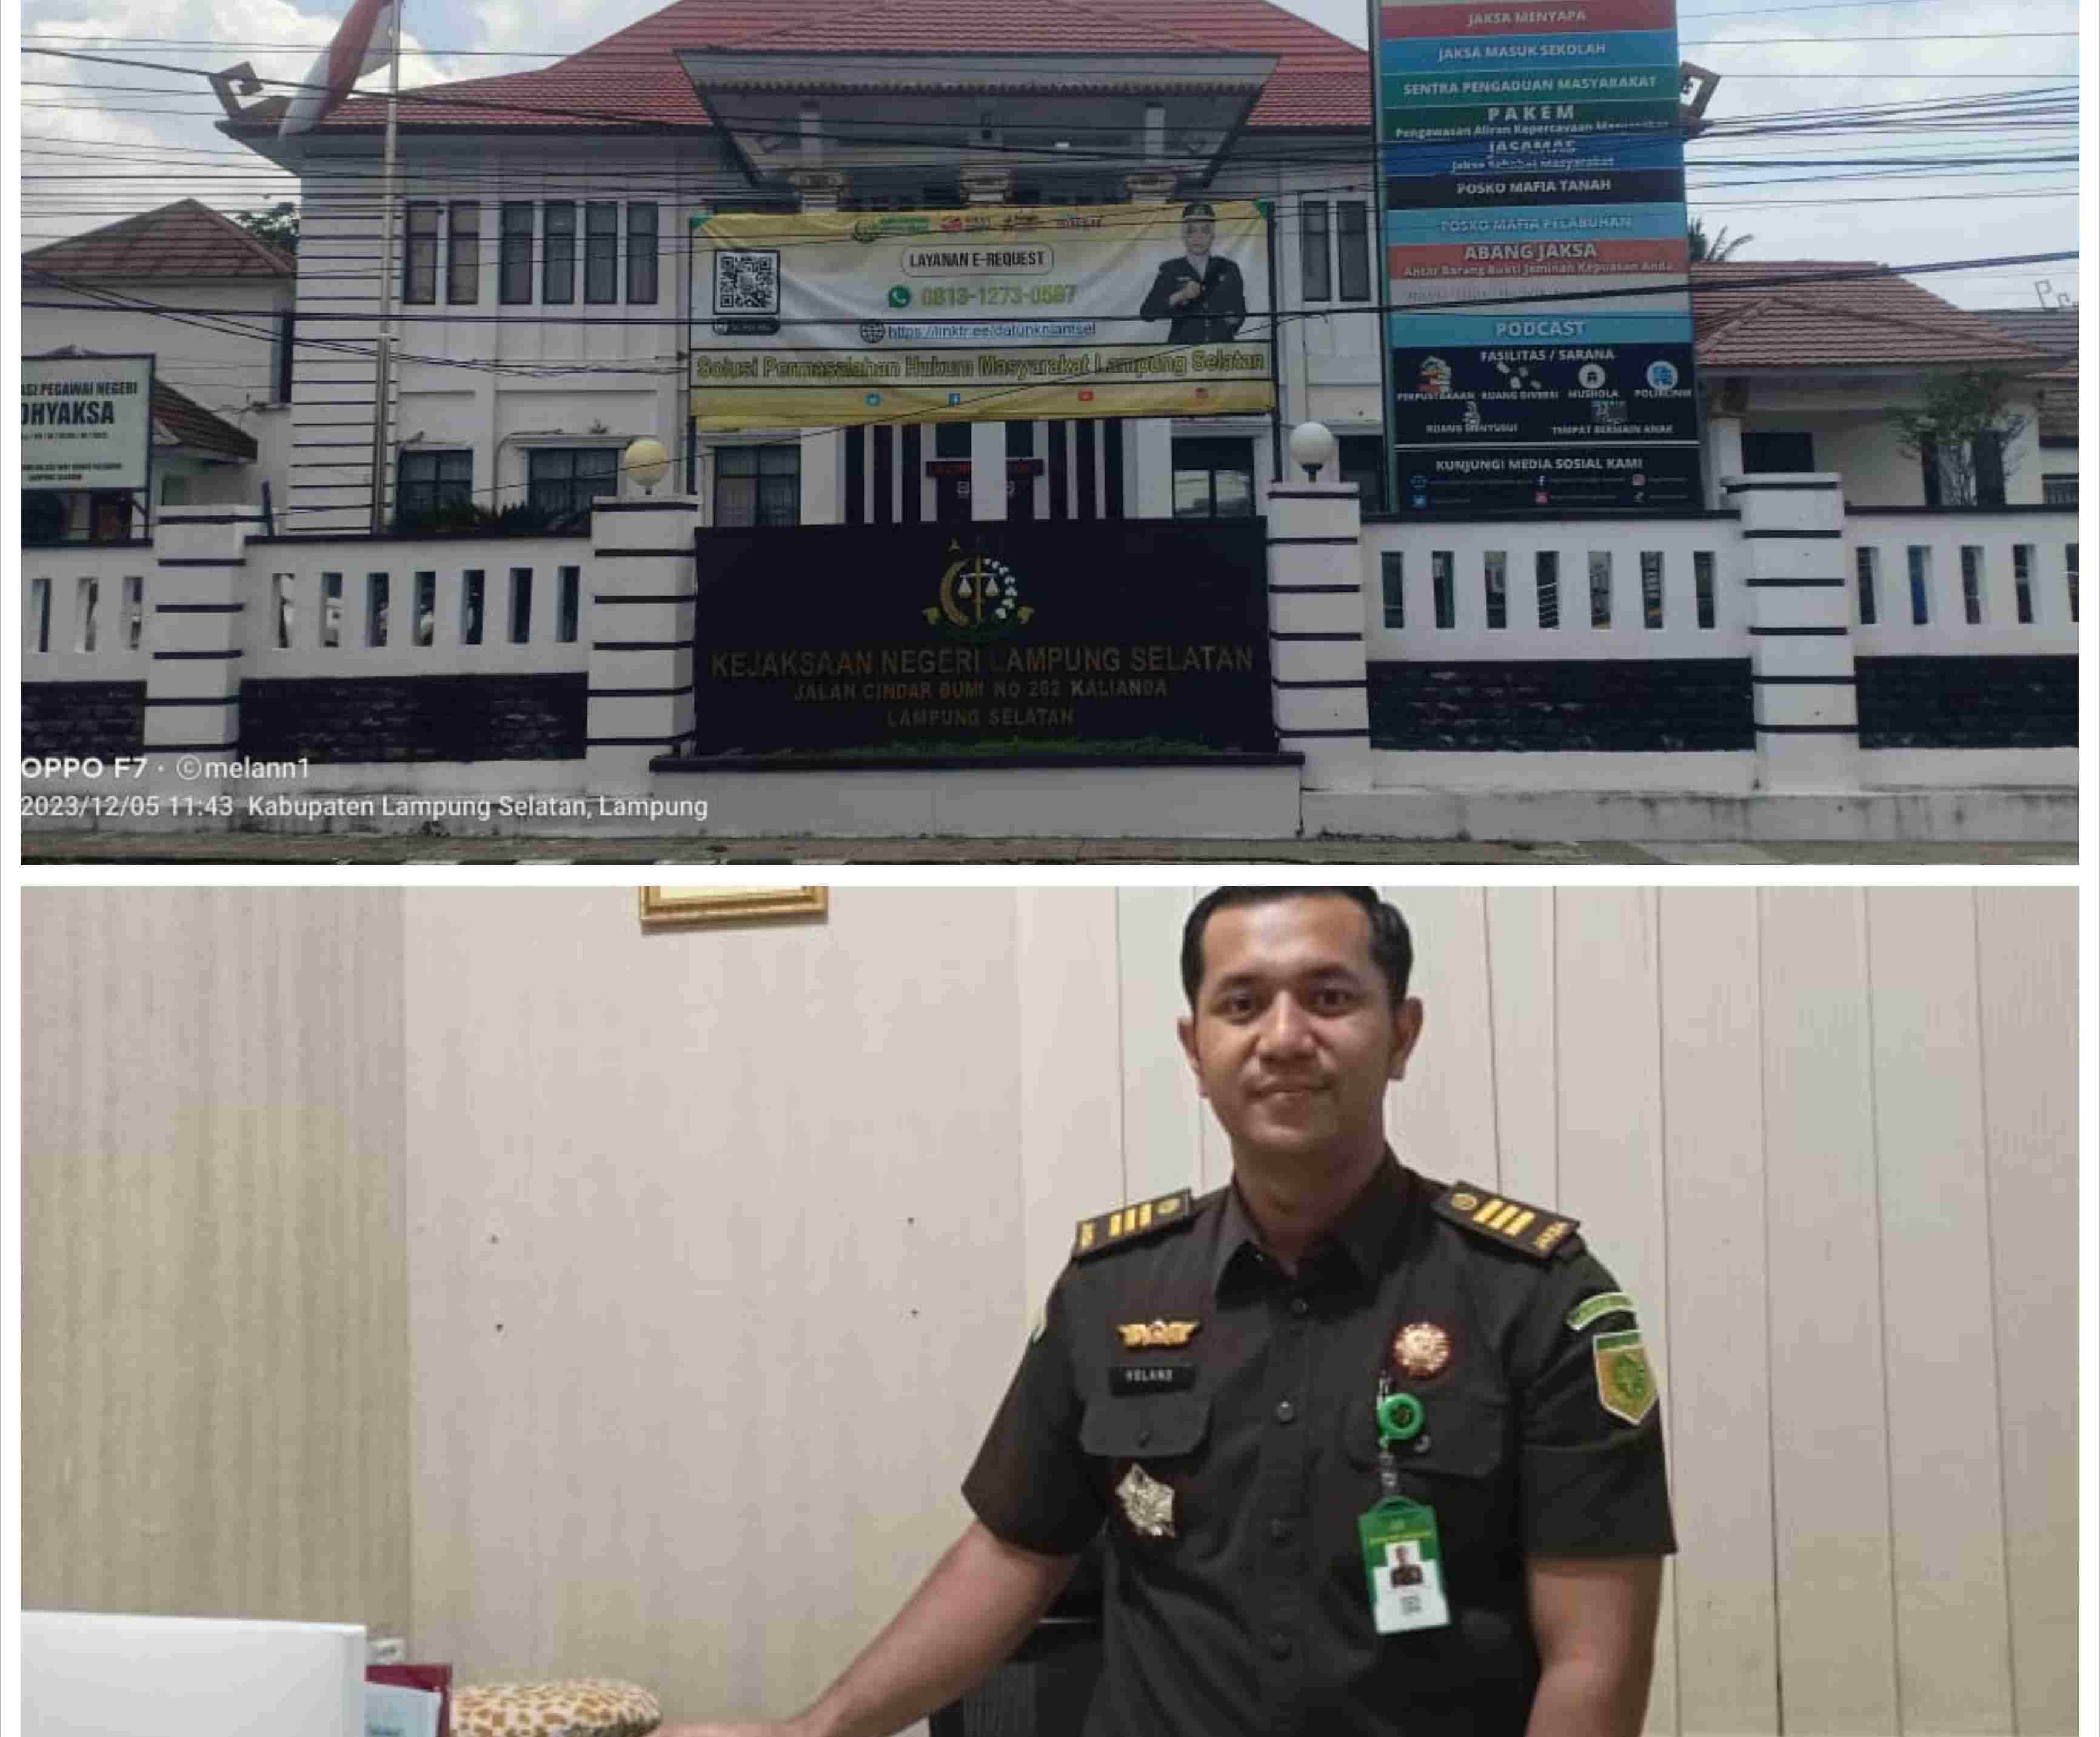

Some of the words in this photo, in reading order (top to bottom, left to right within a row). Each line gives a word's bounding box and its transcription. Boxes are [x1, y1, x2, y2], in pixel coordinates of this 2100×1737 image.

[1467, 12, 1511, 27] JAKSA
[1514, 10, 1587, 23] MENYAPA
[1437, 47, 1481, 62] JAKSA
[1485, 44, 1535, 58] MASUK
[1539, 43, 1606, 56] SEKOLAH
[1403, 82, 1459, 96] SENTRA
[1462, 79, 1554, 93] PENGADUAN
[1557, 76, 1657, 90] MASYARAKAT
[1395, 127, 1471, 140] Pengawasan
[1474, 125, 1511, 136] Aliran
[1457, 182, 1506, 195] POSKO
[1510, 181, 1556, 193] MAFIA
[1559, 179, 1611, 192] TANAH
[909, 252, 968, 268] LAYANAN
[972, 250, 1045, 267] E-REQUEST
[1464, 244, 1533, 260] ABANG
[1536, 242, 1598, 261] JAKSA
[1496, 321, 1586, 336] PODCAST
[1480, 350, 1545, 362] FASILITAS
[1559, 348, 1615, 361] SARANA
[697, 356, 758, 378] Solusi
[763, 356, 901, 378] Permasalahan
[905, 356, 974, 377] Hukum
[978, 354, 1089, 380] Masyarakat
[1094, 353, 1188, 378] Lampung
[1192, 349, 1265, 372] Selatan
[40, 381, 93, 396] PEGAWAI
[96, 381, 138, 395] NEGERI
[1568, 388, 1619, 398] MUSHOLA
[1436, 459, 1505, 473] KUNJUNGI
[1508, 458, 1553, 470] MEDIA
[1554, 458, 1603, 469] SOSIAL
[1606, 458, 1644, 469] KAMI
[711, 648, 874, 679] KEJAKSAAN
[881, 646, 980, 675] NEGERI
[990, 645, 1121, 674] LAMPUNG
[1129, 644, 1253, 673] SELATAN
[795, 682, 855, 701] JALAN
[863, 681, 932, 700] CINDAR
[940, 679, 985, 699] BUMI
[994, 679, 1021, 698] NO
[1068, 678, 1168, 698] KALIANDA
[886, 707, 980, 728] LAMPUNG
[989, 706, 1075, 727] SELATAN
